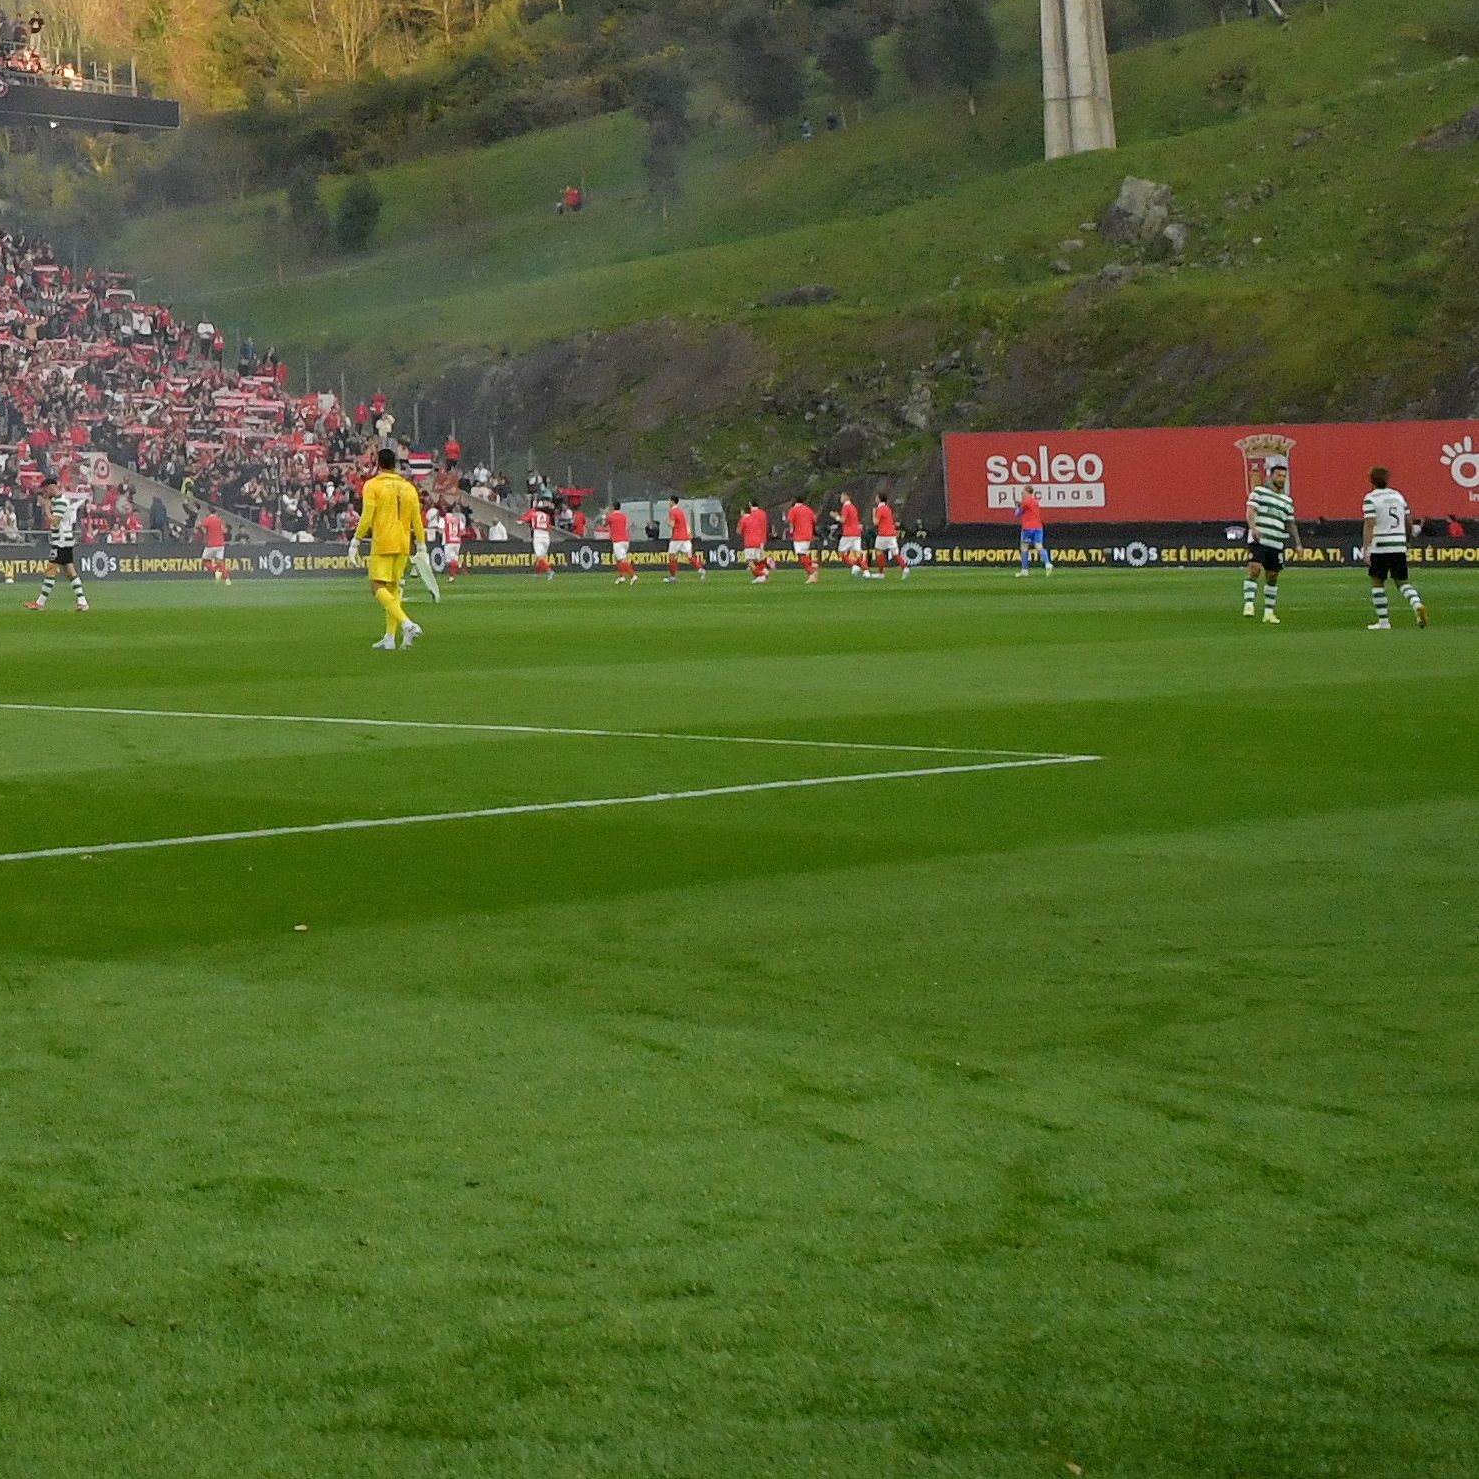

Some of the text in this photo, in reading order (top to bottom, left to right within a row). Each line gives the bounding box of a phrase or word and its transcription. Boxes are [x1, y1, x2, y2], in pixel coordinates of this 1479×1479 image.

[986, 445, 1104, 484] soleo
[998, 486, 1094, 505] picinas
[1388, 507, 1400, 529] 5
[936, 549, 950, 562] SE
[952, 546, 961, 562] É
[1050, 548, 1087, 562] PARA
[1089, 548, 1105, 564] TI,
[1161, 548, 1177, 562] SE
[1179, 545, 1188, 562] É
[1327, 548, 1344, 563] TI,
[1425, 545, 1434, 562] É
[119, 560, 132, 572] SE
[133, 555, 140, 572] É
